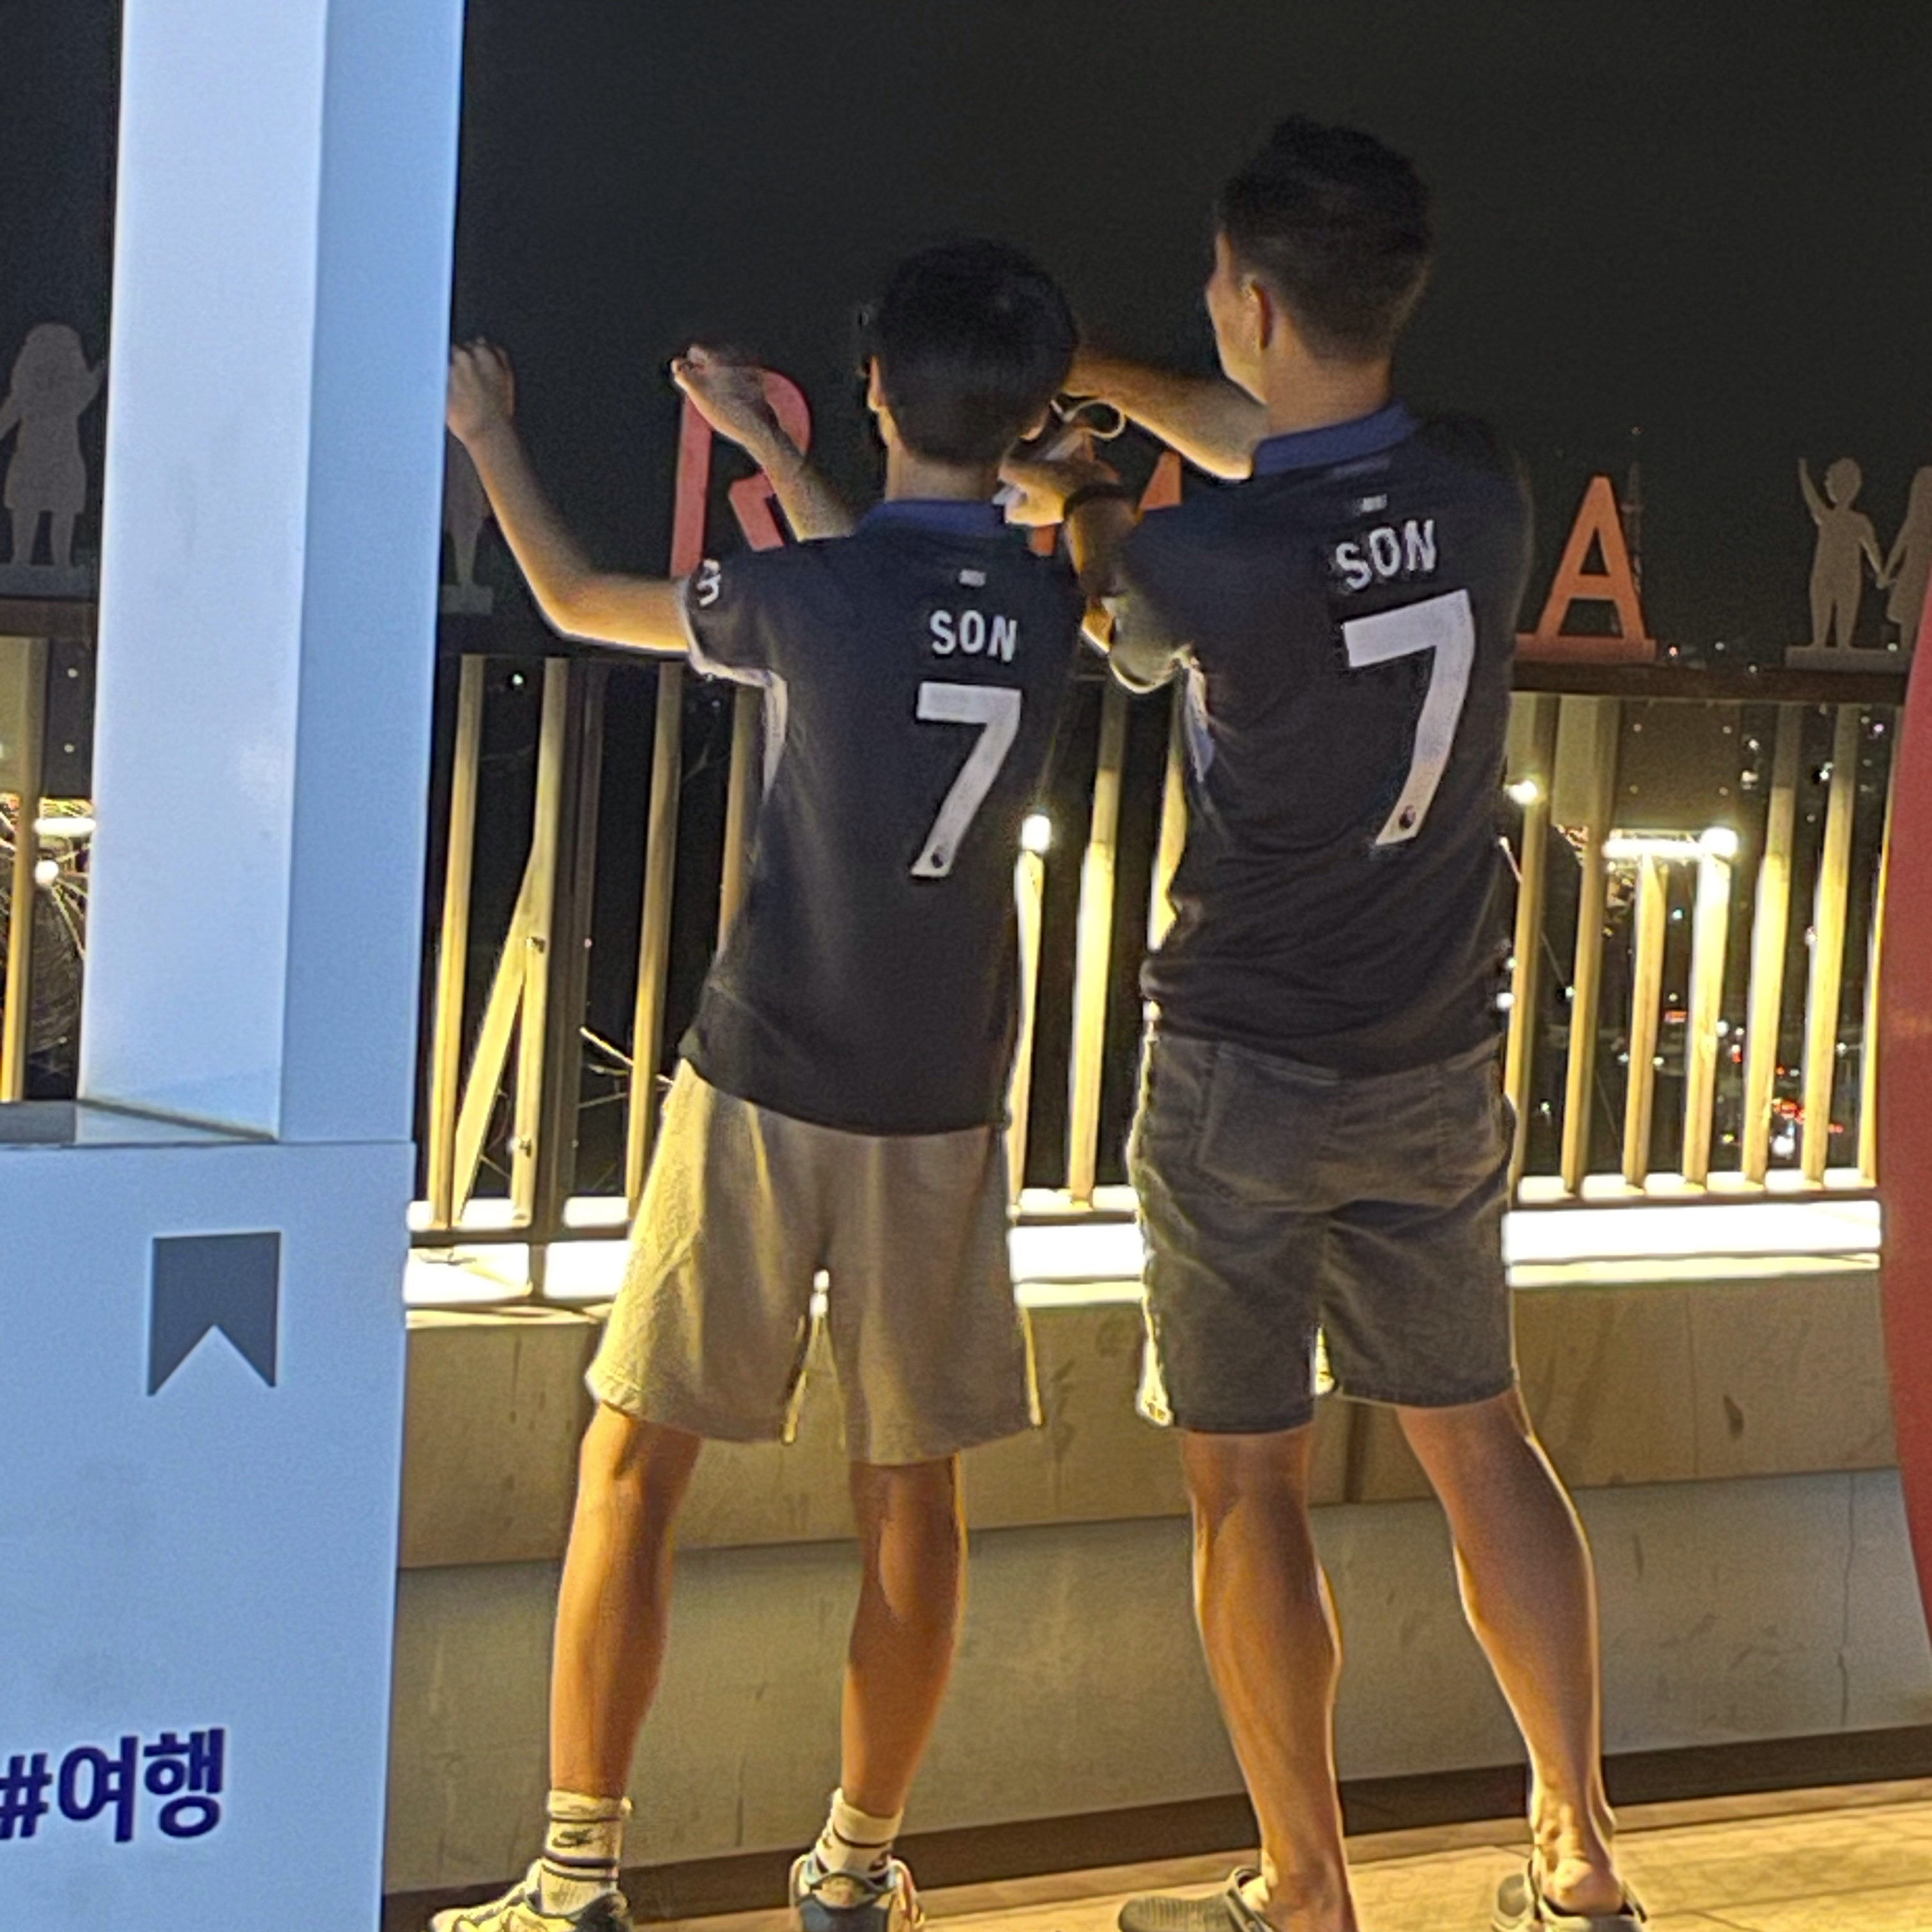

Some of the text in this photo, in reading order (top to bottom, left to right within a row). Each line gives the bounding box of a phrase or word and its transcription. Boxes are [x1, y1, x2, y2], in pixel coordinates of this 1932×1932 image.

[1335, 519, 1437, 590] SON
[930, 610, 1018, 662] SON
[1343, 588, 1475, 846] 7
[910, 682, 1022, 877] 7
[0, 1728, 224, 1843] #여행
